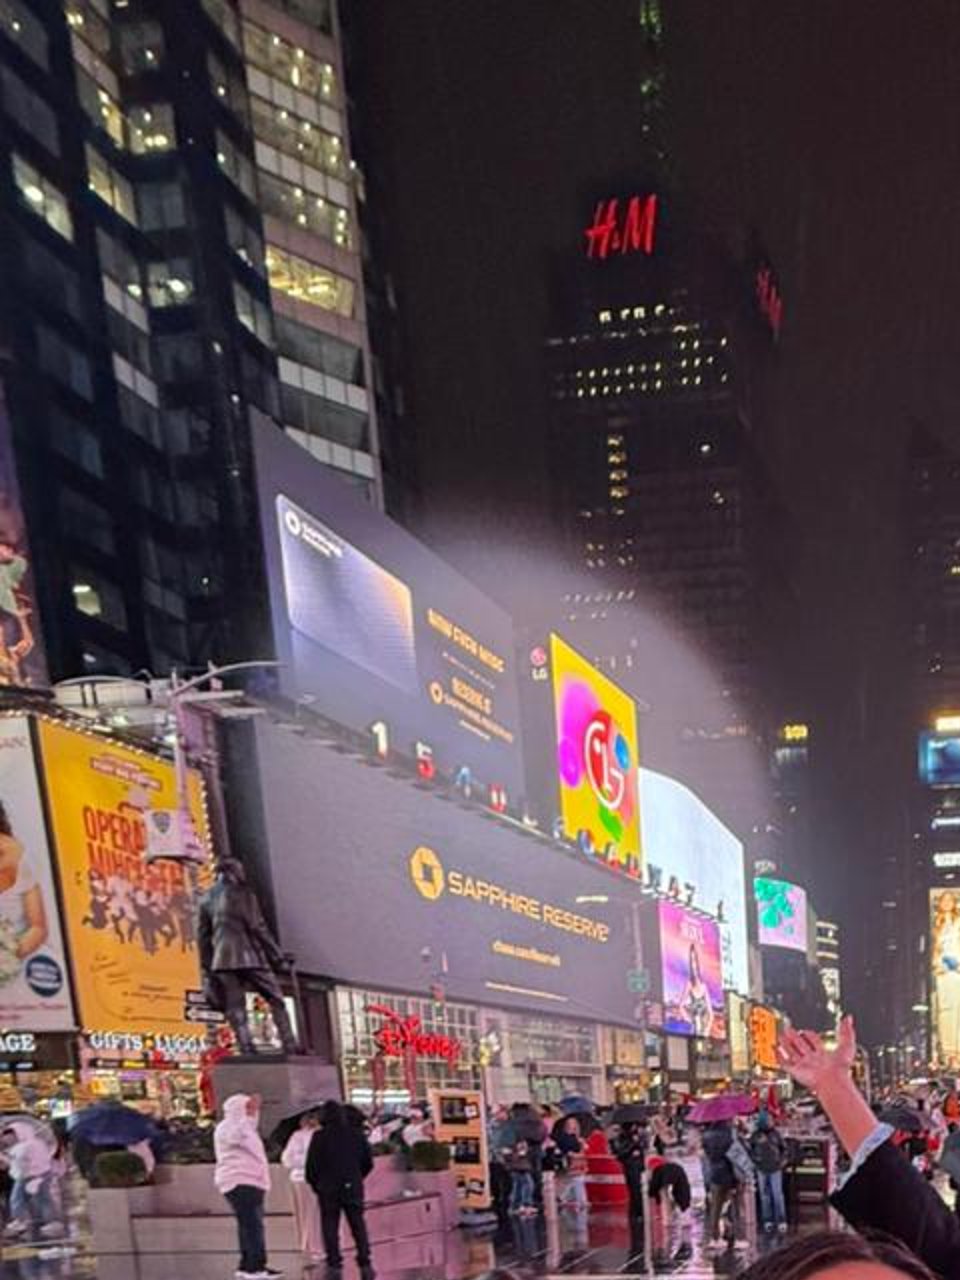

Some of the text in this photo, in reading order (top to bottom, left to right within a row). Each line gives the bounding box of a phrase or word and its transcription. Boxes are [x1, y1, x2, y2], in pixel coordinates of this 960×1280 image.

[449, 870, 610, 943] SAPPHIRE RESERVE
[90, 1031, 143, 1050] GIFTS
